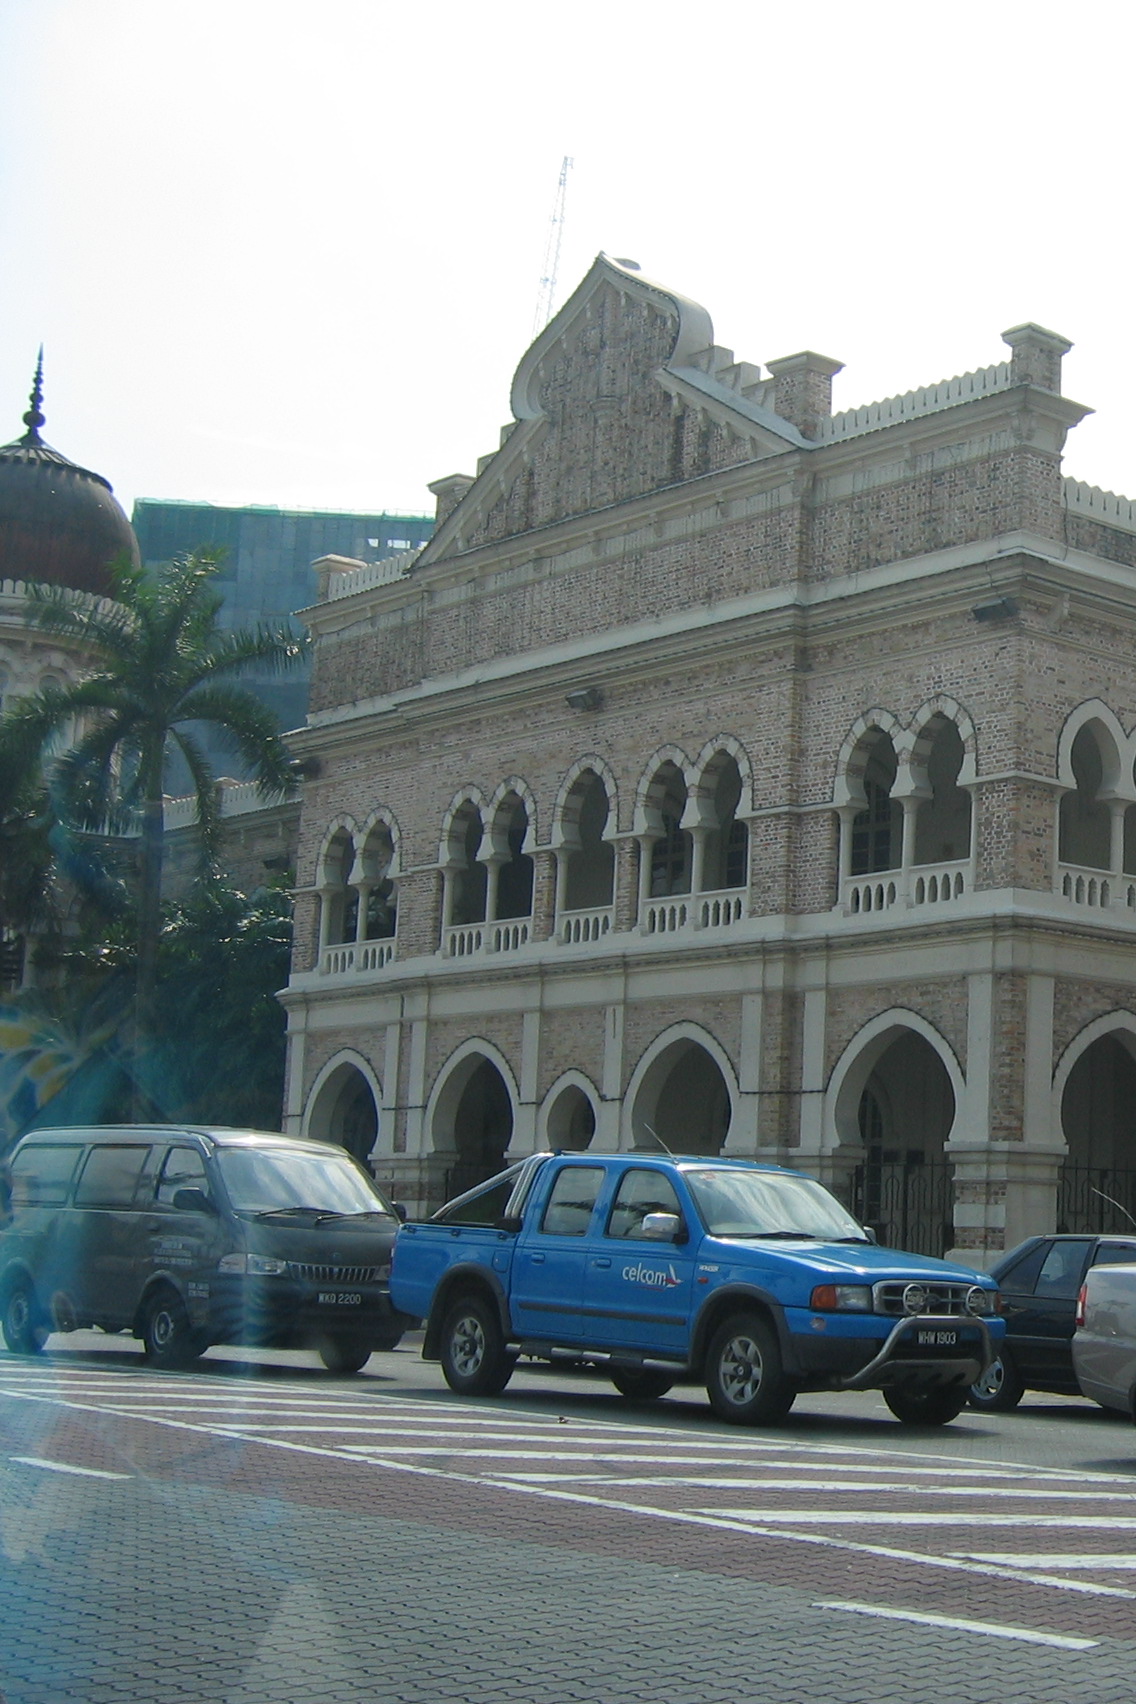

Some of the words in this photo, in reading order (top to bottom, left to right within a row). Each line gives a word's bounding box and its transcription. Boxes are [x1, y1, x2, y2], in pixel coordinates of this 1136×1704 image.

[622, 1262, 666, 1286] celcom
[338, 1293, 361, 1304] 2200
[936, 1331, 956, 1345] 1903
